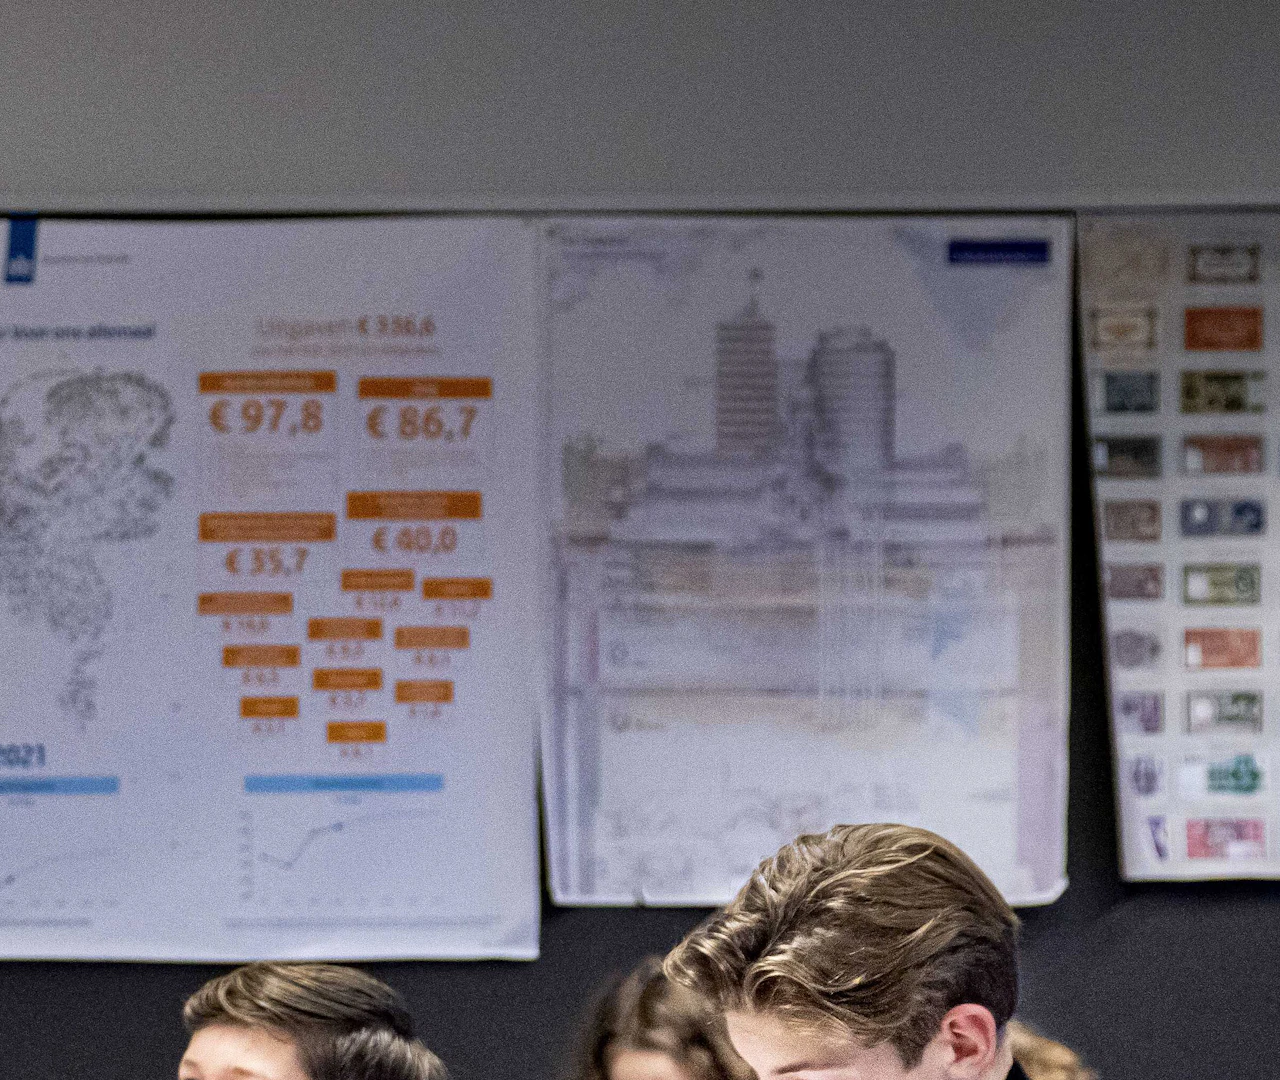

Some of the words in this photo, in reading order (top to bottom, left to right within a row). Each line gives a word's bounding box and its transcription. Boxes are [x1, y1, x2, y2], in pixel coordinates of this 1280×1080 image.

[208, 400, 230, 433] €
[241, 399, 323, 437] 97,8
[366, 406, 387, 439] €
[398, 405, 478, 442] 86,7
[372, 527, 387, 552] €
[225, 549, 238, 574] €
